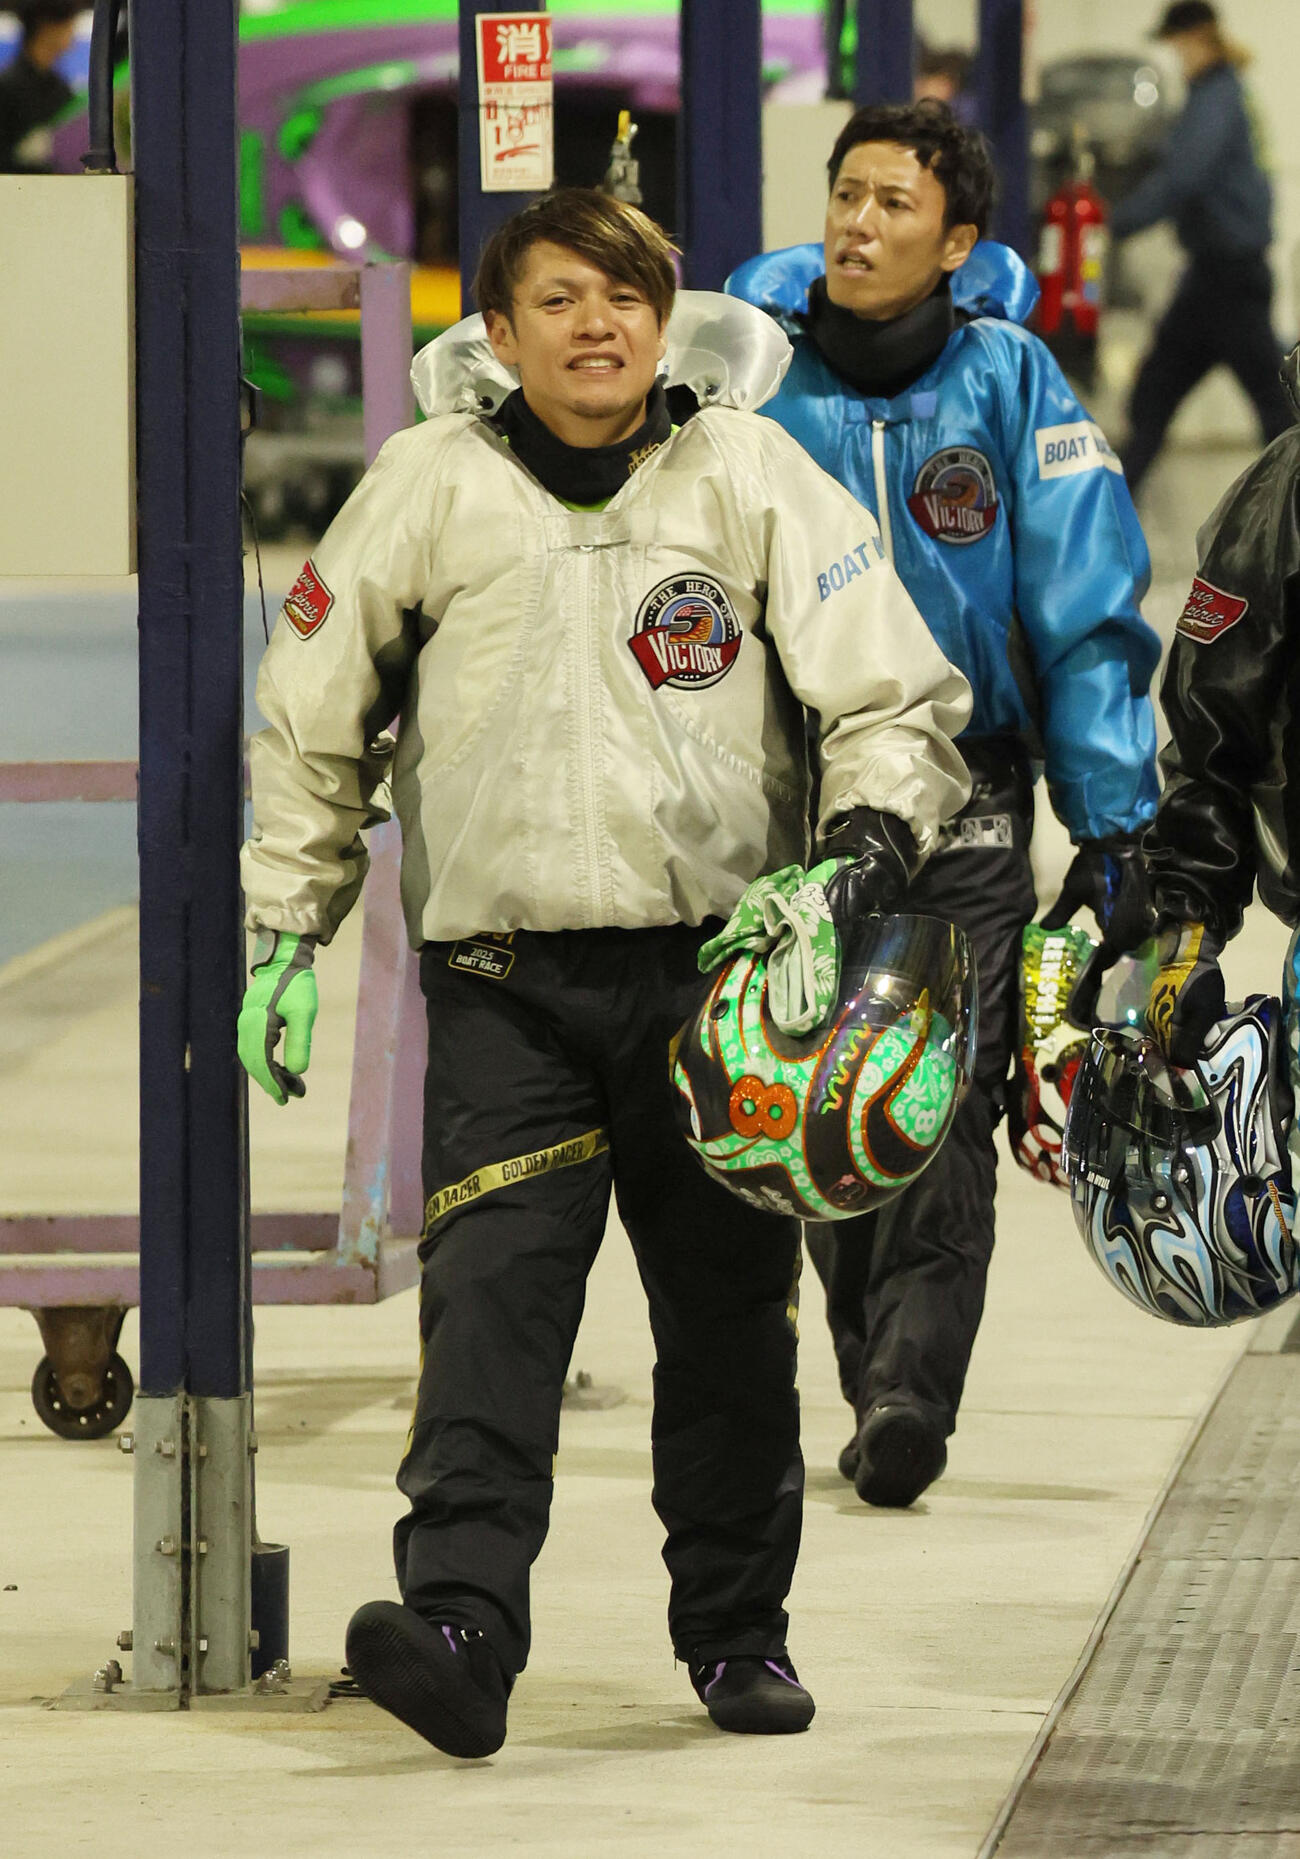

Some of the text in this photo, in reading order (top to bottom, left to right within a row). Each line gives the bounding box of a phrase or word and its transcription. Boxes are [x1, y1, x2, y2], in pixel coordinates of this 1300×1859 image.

[503, 64, 538, 78] FIRE
[1044, 435, 1088, 465] BOAT
[923, 494, 984, 532] VICTORY
[817, 542, 870, 602] BOAT
[650, 585, 678, 610] THE
[685, 581, 718, 600] HERO
[647, 631, 723, 674] VICTORY
[455, 954, 503, 973] BOAT RACE
[470, 948, 495, 960] 2025
[502, 1141, 583, 1181] GOLDEN RACER
[442, 1175, 481, 1212] RACER
